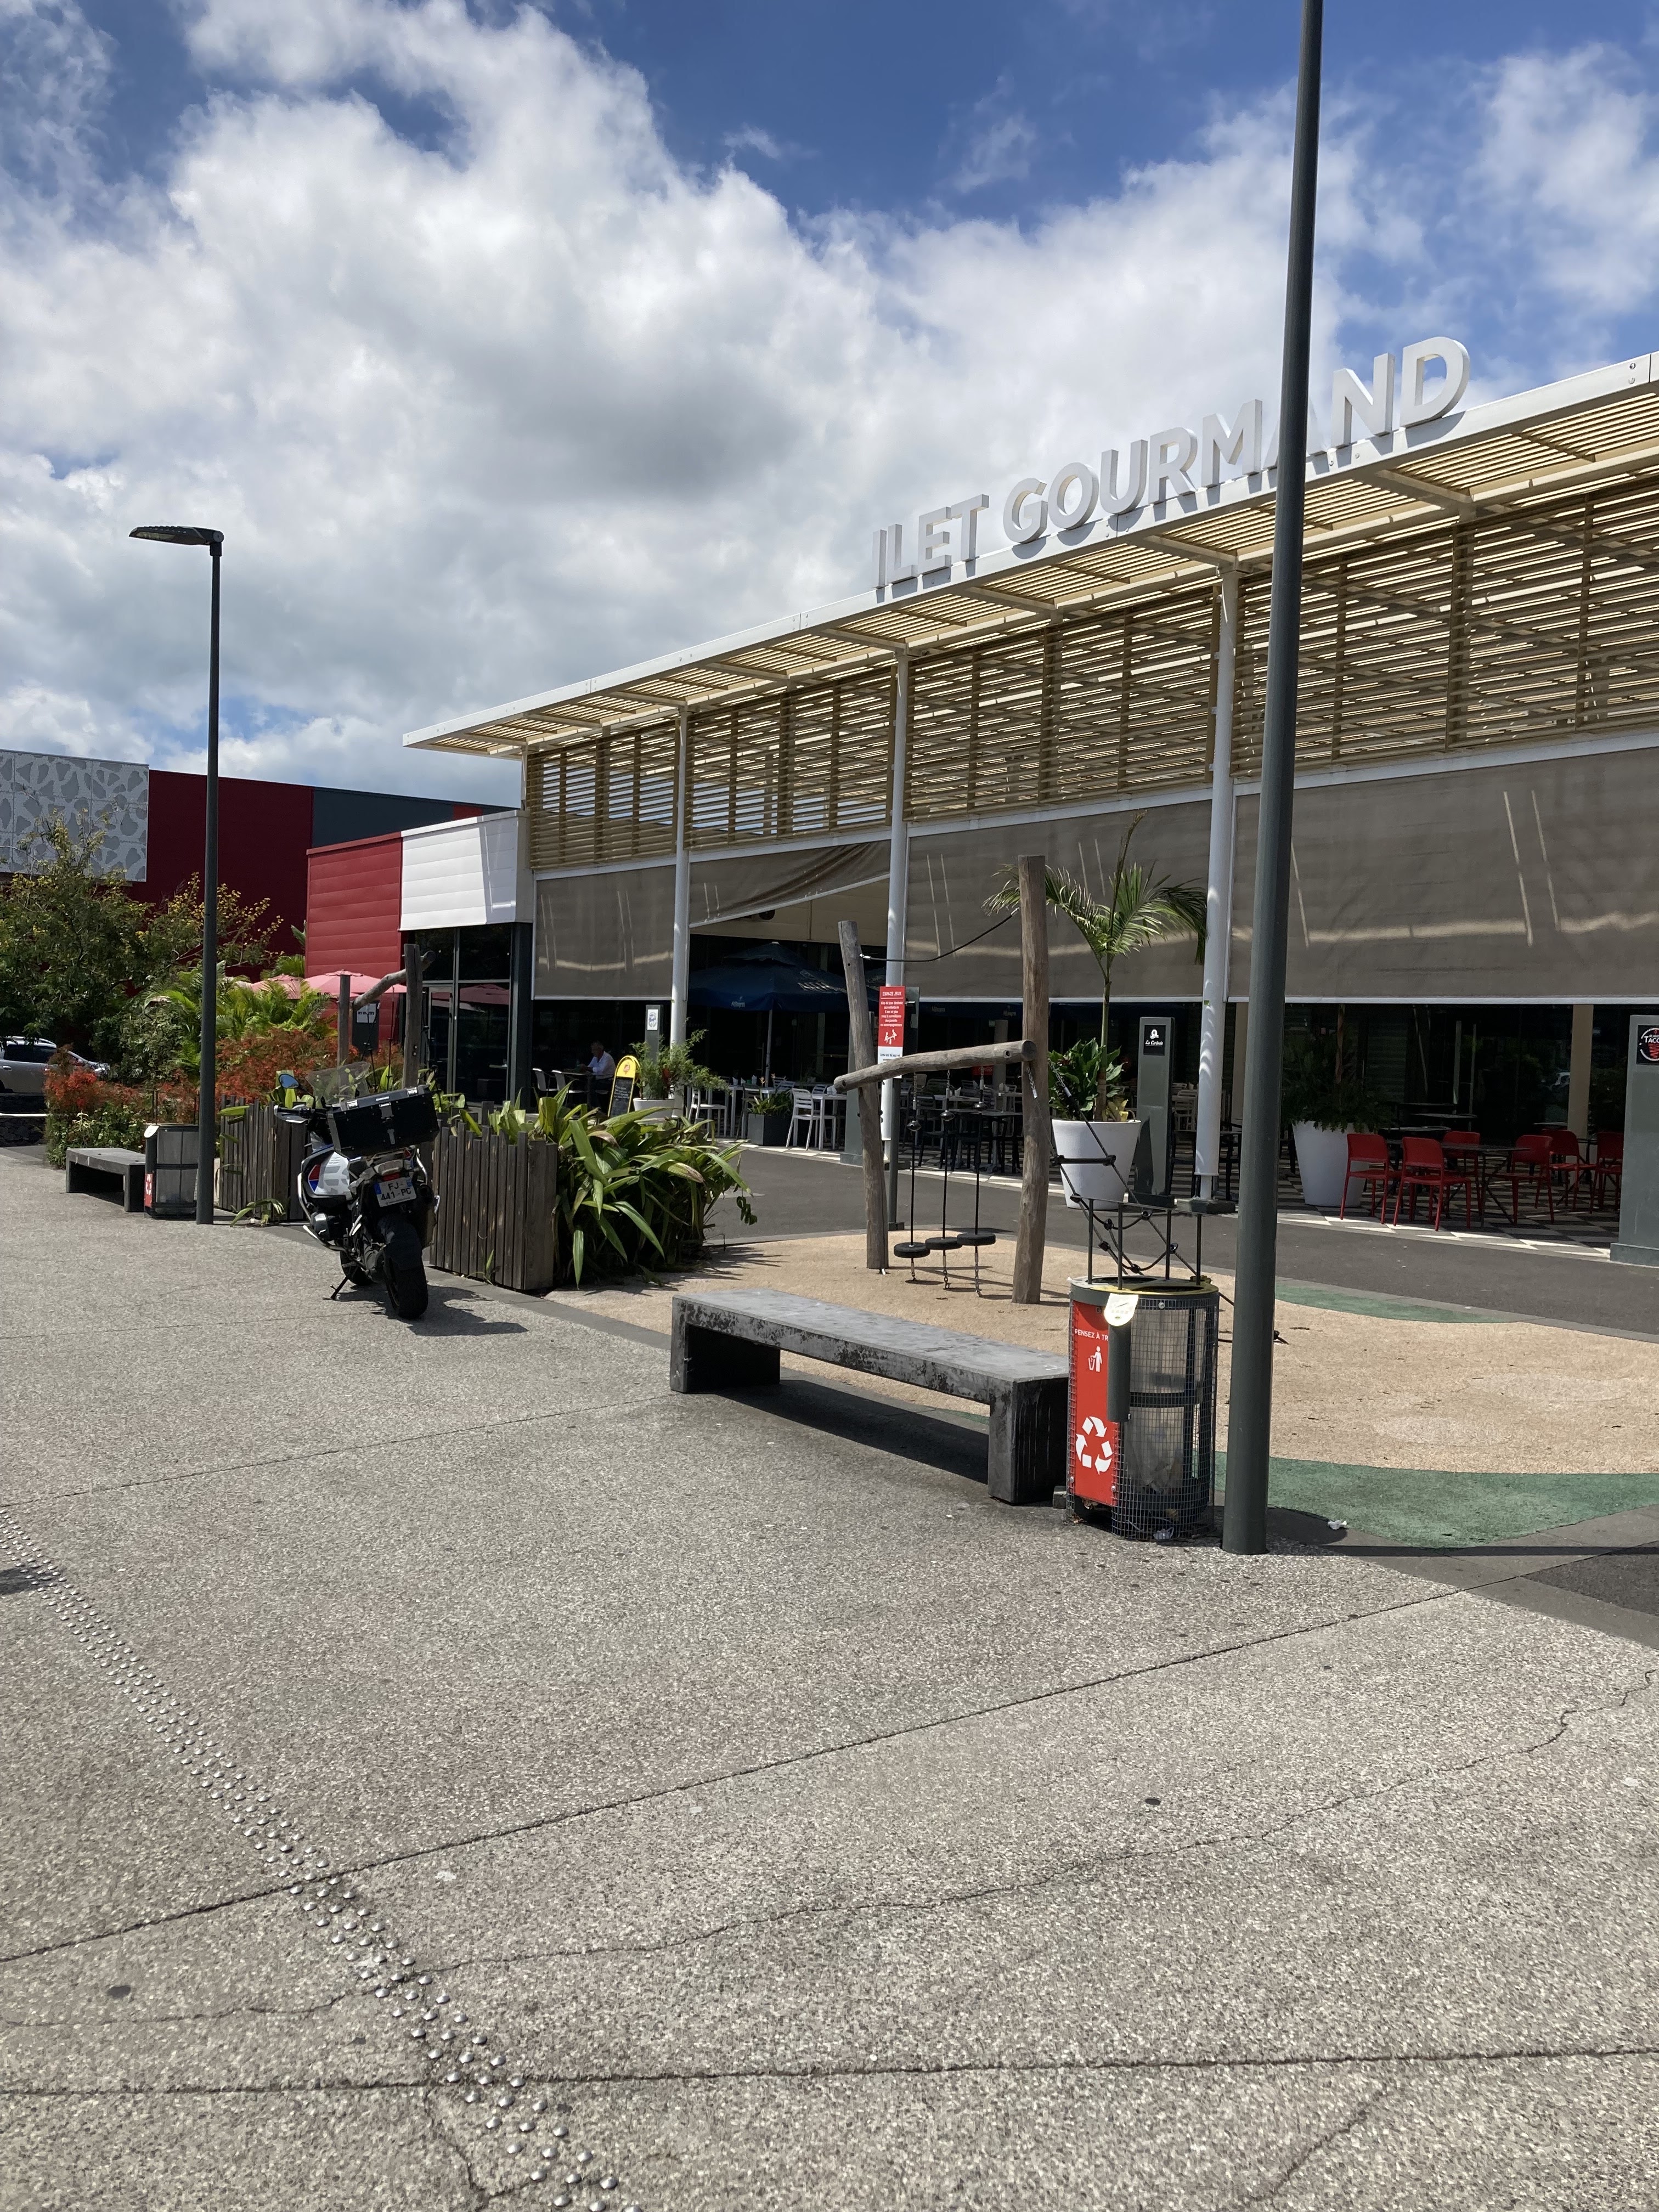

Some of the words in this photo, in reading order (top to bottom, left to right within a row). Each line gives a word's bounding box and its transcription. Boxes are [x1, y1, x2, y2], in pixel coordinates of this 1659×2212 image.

[872, 495, 989, 589] ILET
[1074, 1328, 1095, 1339] PENSEZ
[1096, 1330, 1101, 1340] À
